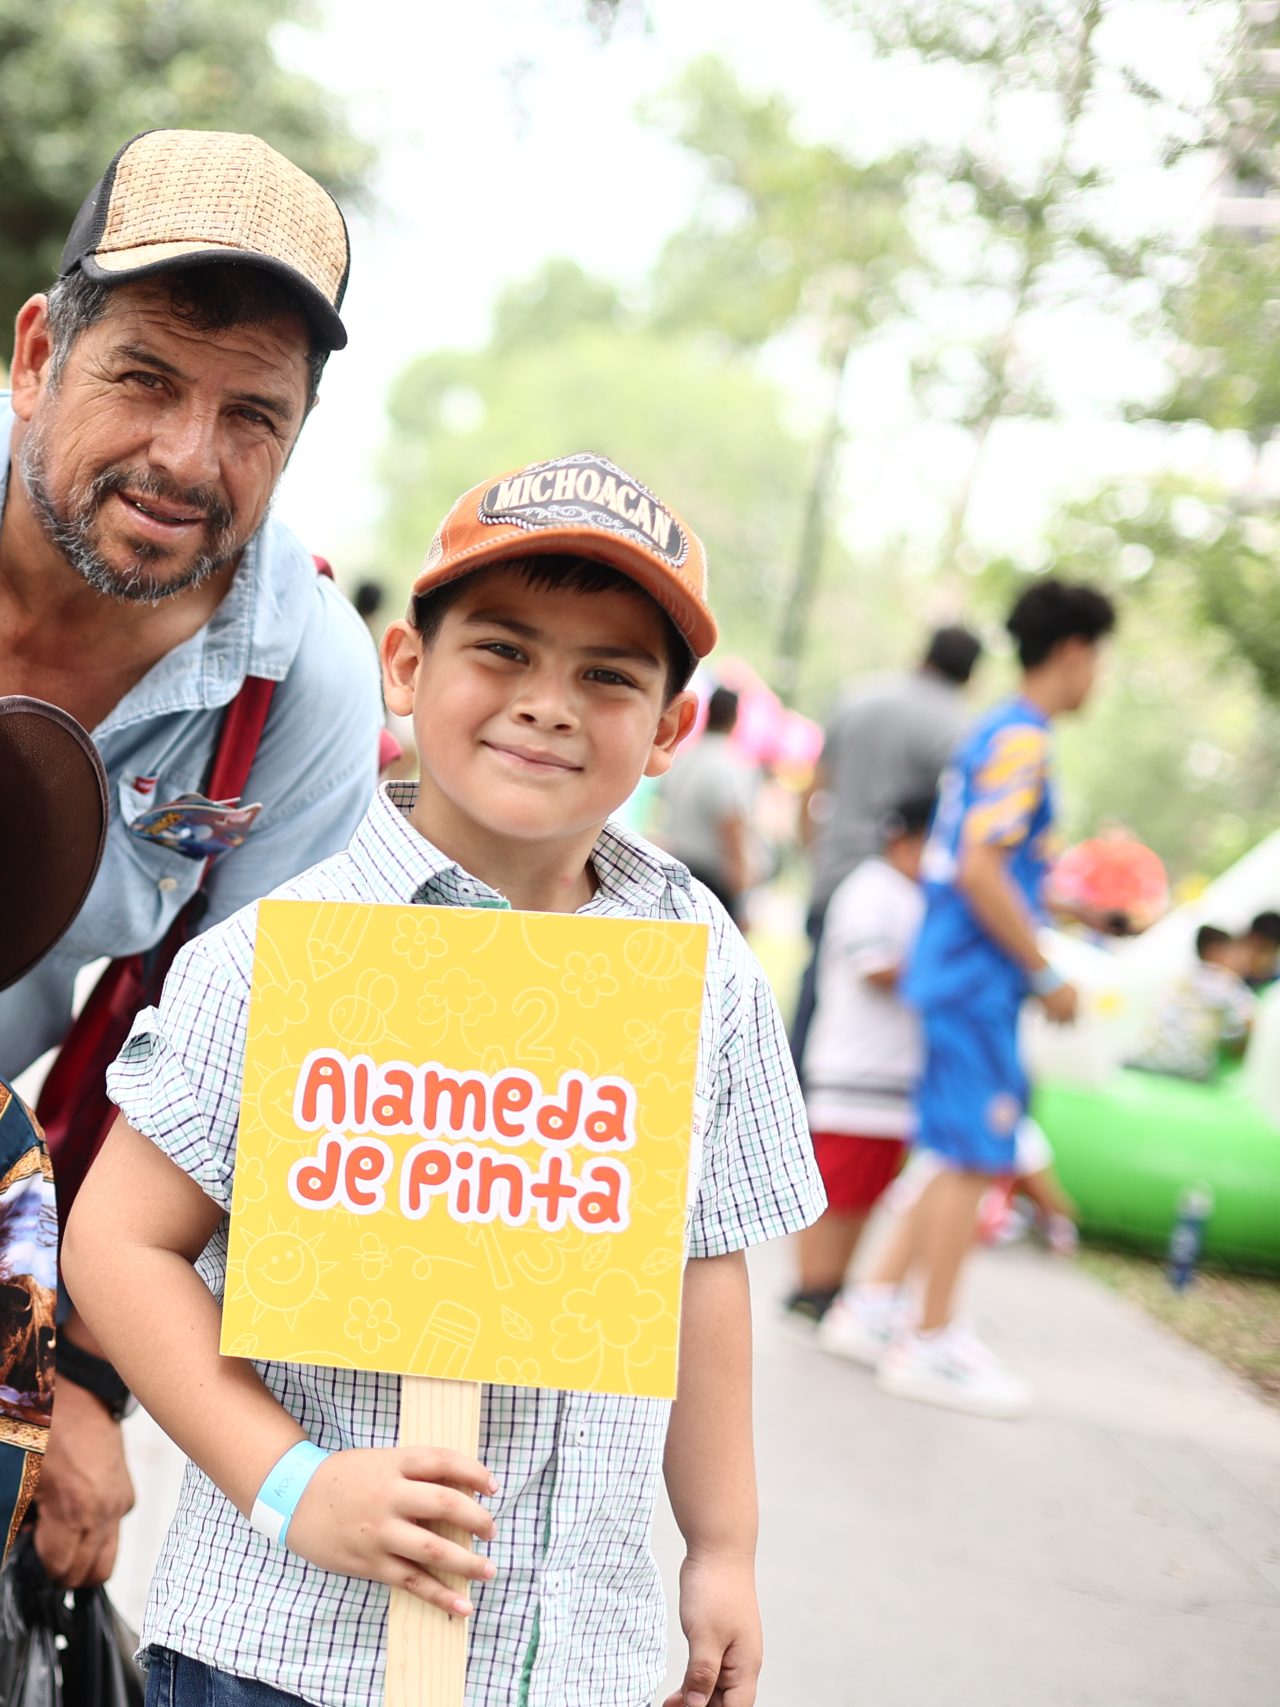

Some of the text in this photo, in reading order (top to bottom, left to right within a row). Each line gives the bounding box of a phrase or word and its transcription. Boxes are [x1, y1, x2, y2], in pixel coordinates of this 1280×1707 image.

[495, 468, 673, 551] MICHOACAN
[301, 1056, 628, 1143] Alameda
[296, 1140, 385, 1207] de
